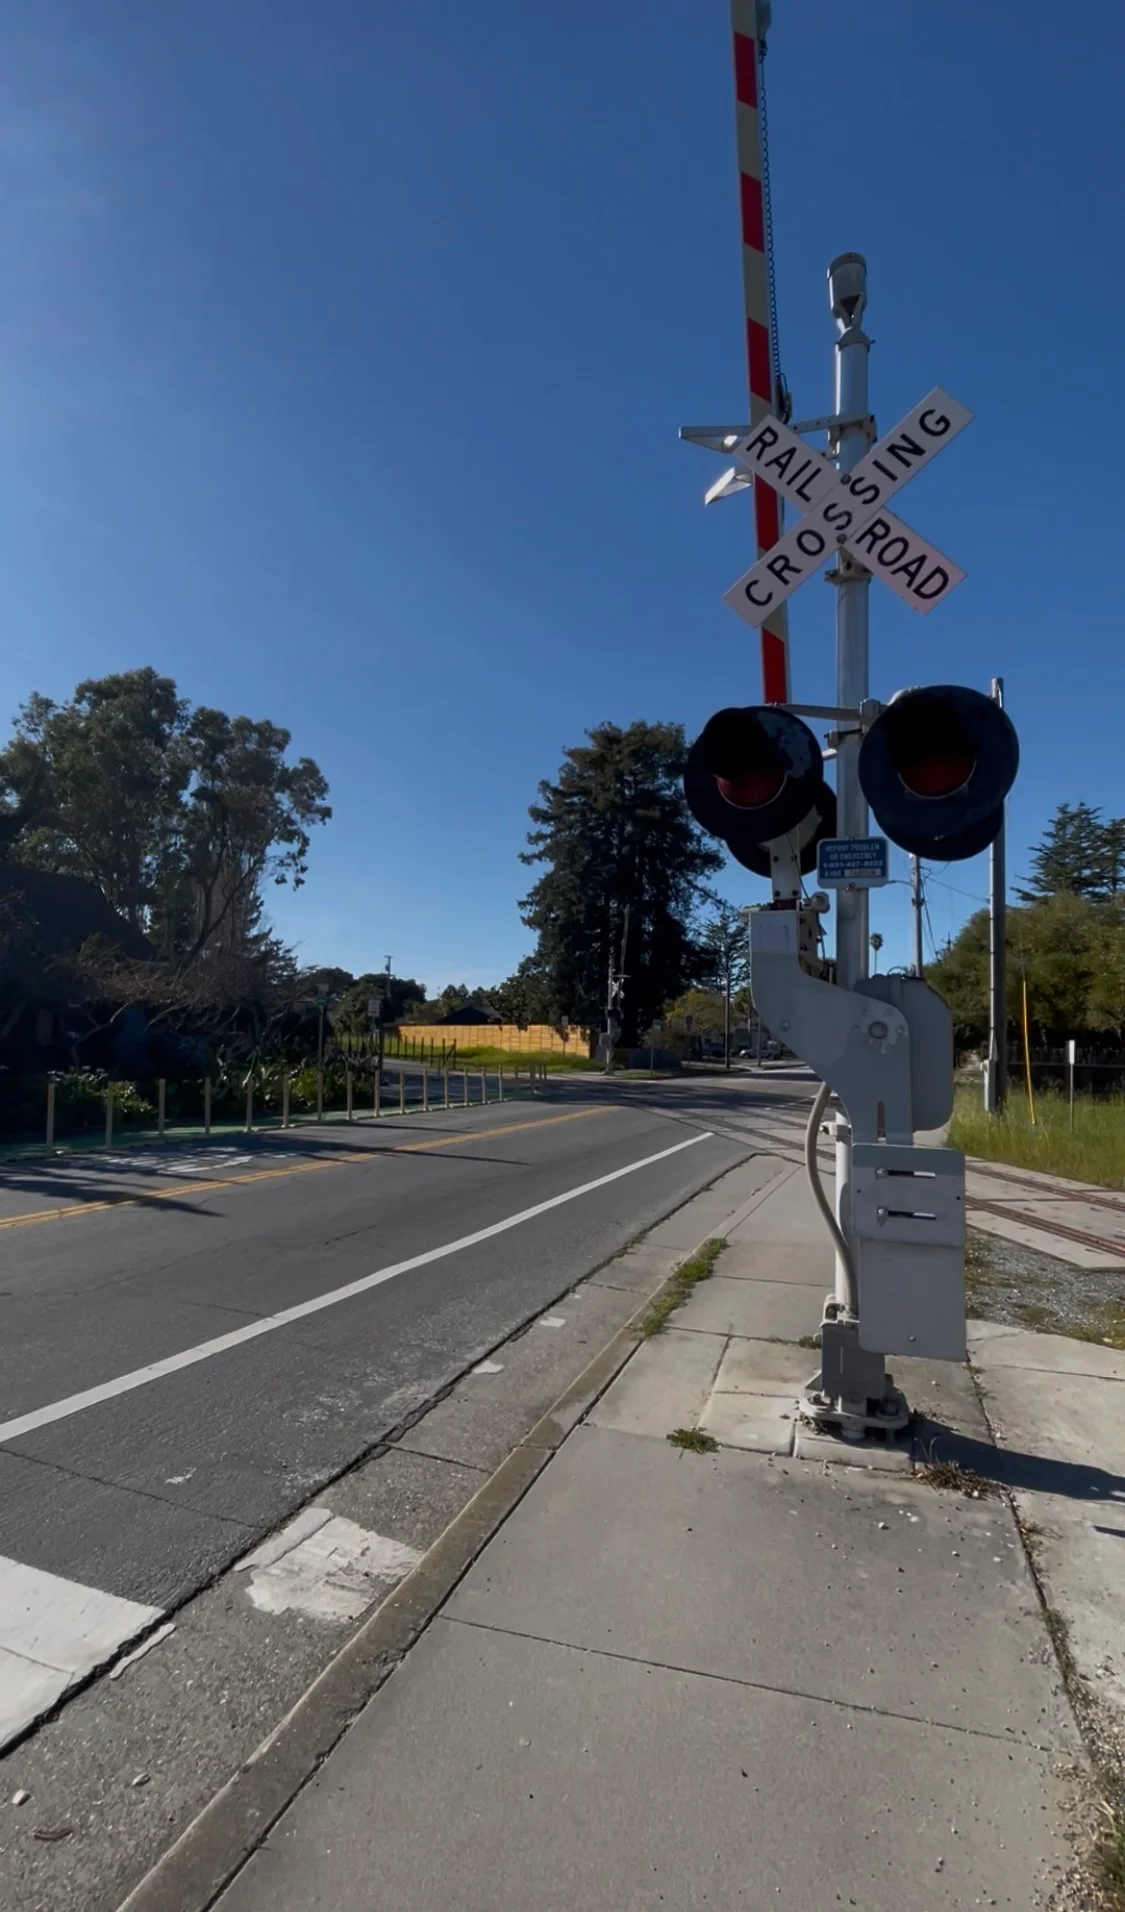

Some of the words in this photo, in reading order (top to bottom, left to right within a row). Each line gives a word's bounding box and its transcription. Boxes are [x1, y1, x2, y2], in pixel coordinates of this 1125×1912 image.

[744, 408, 951, 607] CROSSING
[745, 425, 823, 503] RAIL
[855, 517, 950, 600] ROAD
[840, 852, 877, 860] EMERGENCY
